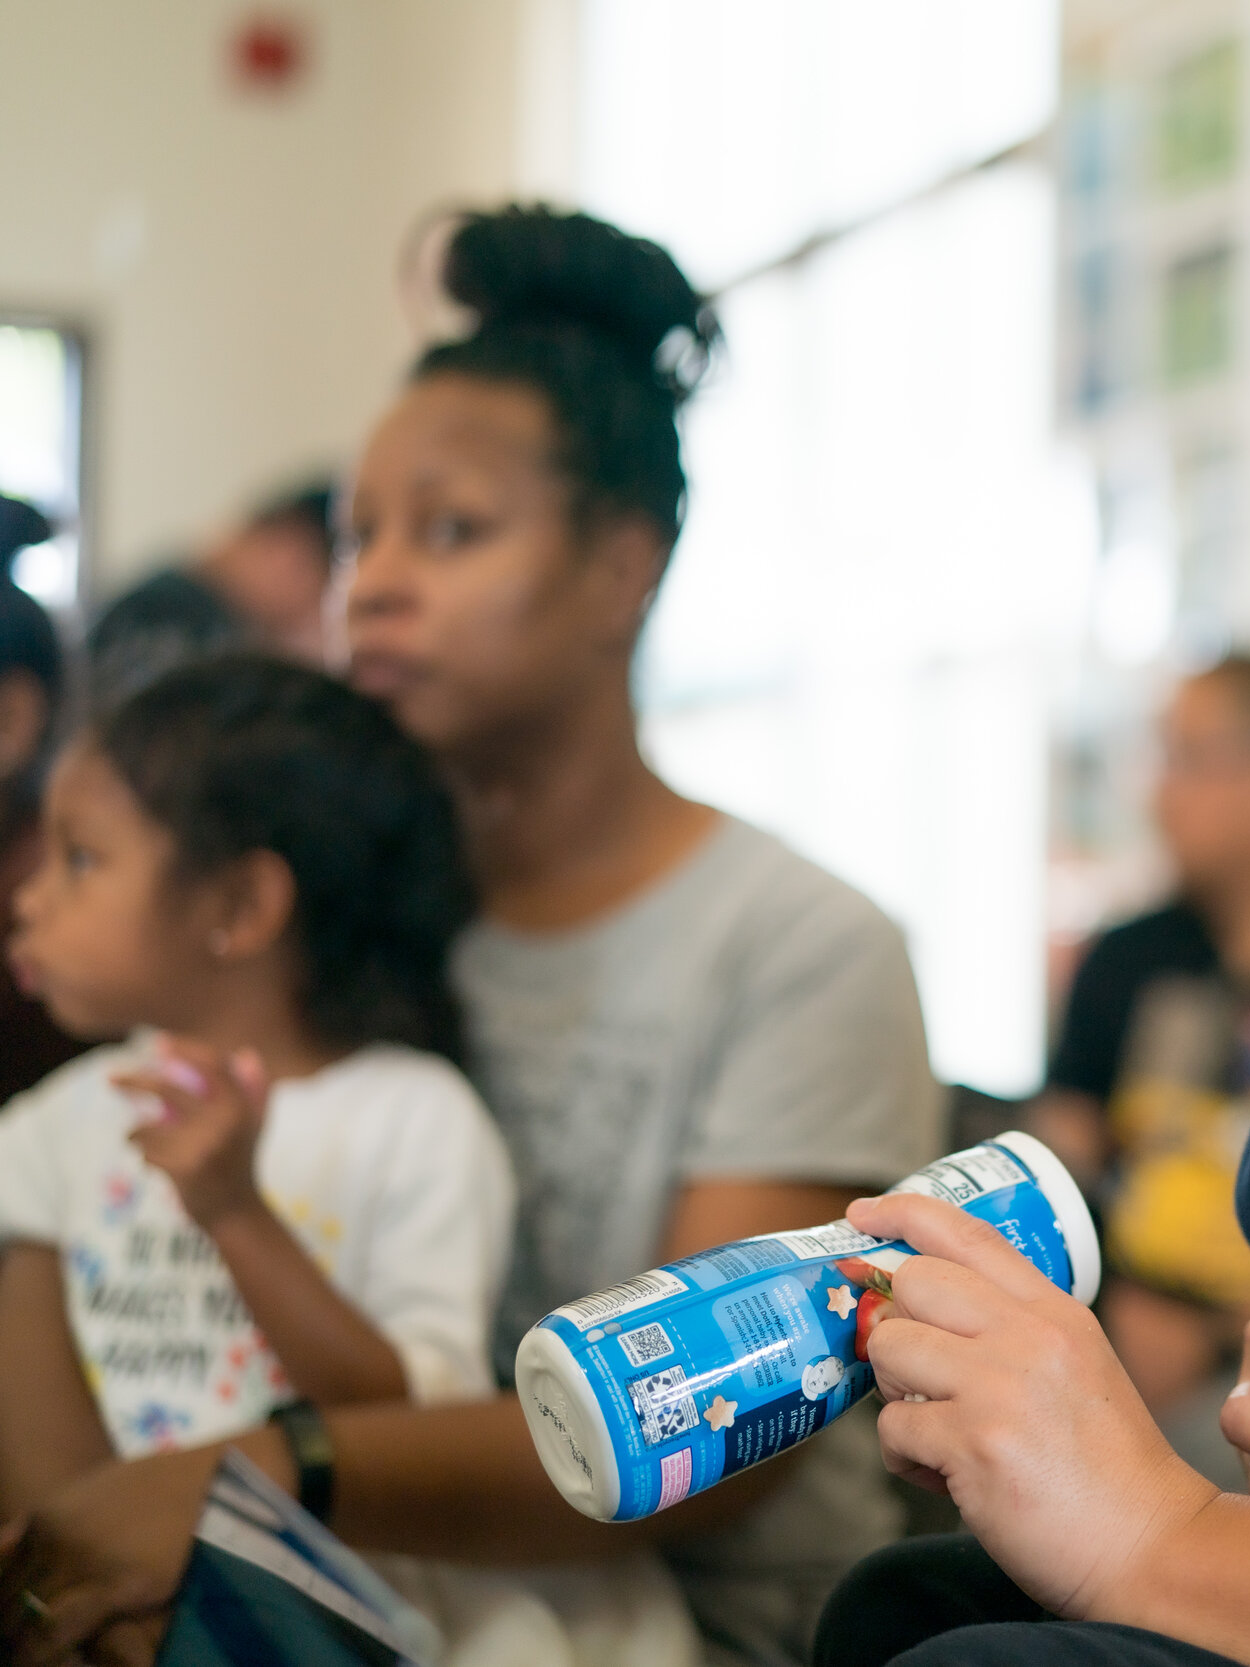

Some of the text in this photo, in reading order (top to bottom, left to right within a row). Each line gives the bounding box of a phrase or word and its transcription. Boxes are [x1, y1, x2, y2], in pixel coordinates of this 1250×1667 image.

[953, 1180, 975, 1199] 25
[995, 1217, 1024, 1250] first
[596, 1299, 625, 1314] 15000
[628, 1286, 660, 1303] 04520
[724, 1305, 734, 1315] For
[741, 1298, 760, 1324] personal
[772, 1287, 789, 1309] when
[783, 1309, 796, 1326] you
[737, 1309, 753, 1334] anytime:
[751, 1295, 763, 1310] meet
[759, 1310, 772, 1327] Dotti,
[767, 1327, 778, 1340] your
[760, 1291, 774, 1310] Head
[769, 1307, 776, 1315] to
[790, 1358, 797, 1366] to
[794, 1306, 810, 1334] awake
[756, 1323, 767, 1339] baby
[620, 1336, 639, 1365] LEARN MORE
[771, 1360, 779, 1370] Or
[773, 1370, 783, 1383] call
[634, 1382, 649, 1410] PLASTIC
[800, 1404, 806, 1414] be
[808, 1406, 816, 1423] Your
[769, 1418, 774, 1426] on
[796, 1415, 805, 1433] ready
